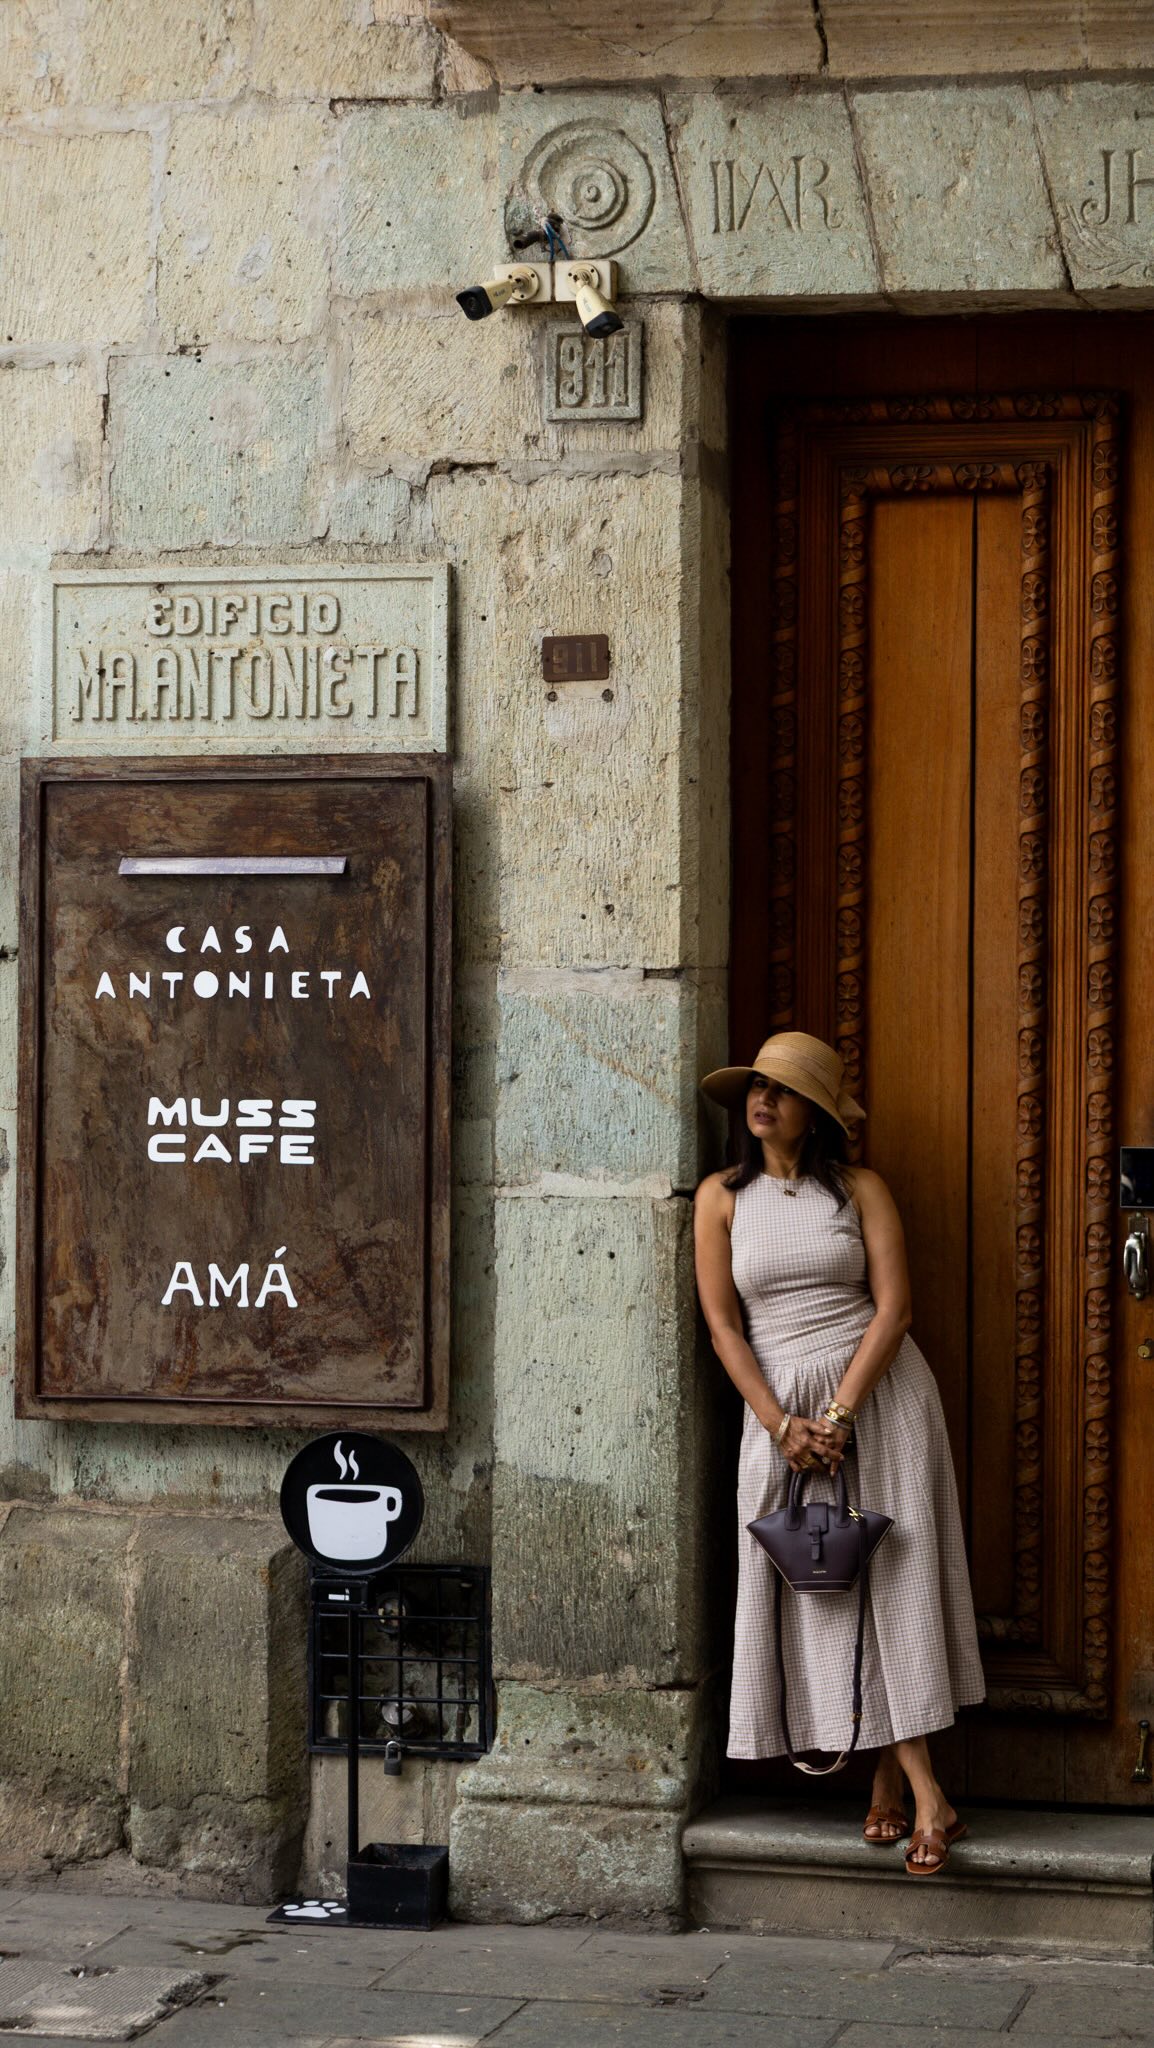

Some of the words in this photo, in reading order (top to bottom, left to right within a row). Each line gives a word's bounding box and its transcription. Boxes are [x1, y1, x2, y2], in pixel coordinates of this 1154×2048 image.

[560, 335, 630, 407] 911
[146, 592, 341, 637] EDIFICIO
[552, 642, 597, 673] 911
[166, 926, 289, 953] CASA
[95, 971, 370, 999] ANTONIETA
[148, 1097, 316, 1127] MUSS
[148, 1134, 314, 1164] CAFE
[161, 1246, 297, 1307] AMÁ
